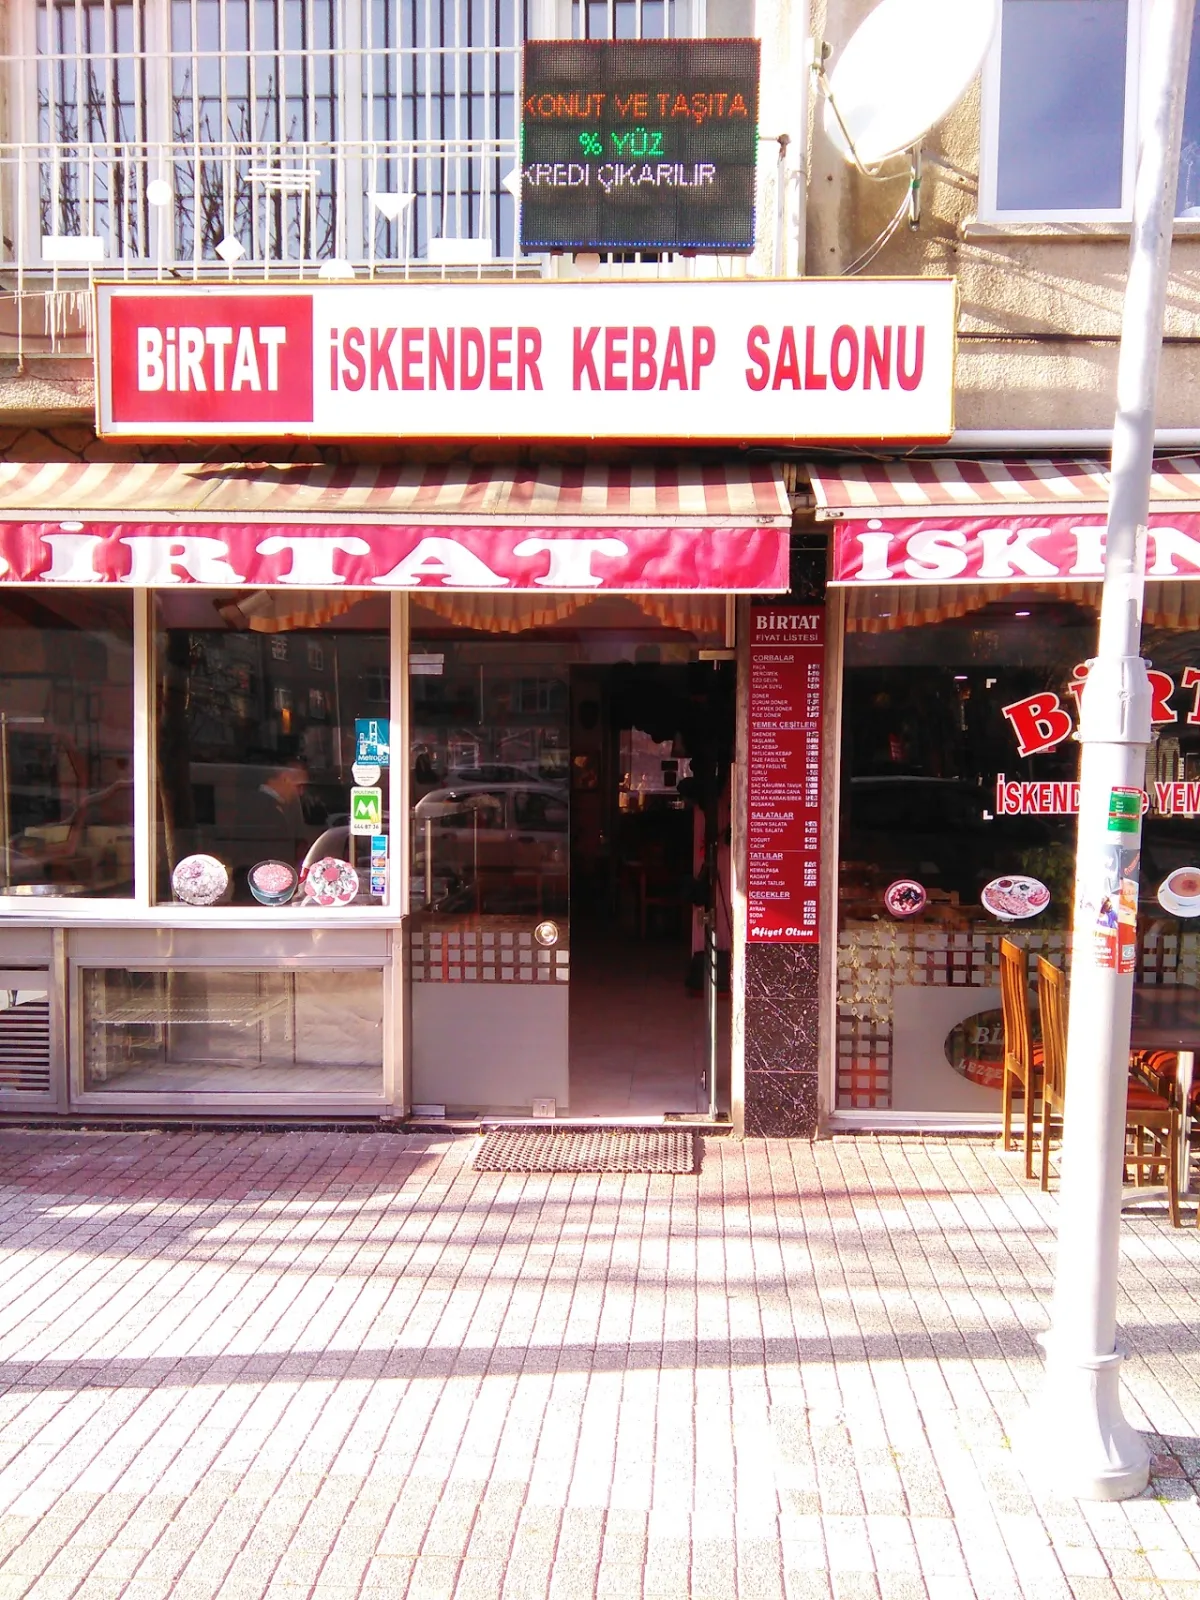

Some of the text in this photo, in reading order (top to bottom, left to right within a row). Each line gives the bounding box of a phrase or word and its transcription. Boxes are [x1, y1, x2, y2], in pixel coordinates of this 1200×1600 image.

[524, 93, 748, 123] KONUT VE TAŞITA
[579, 127, 664, 155] % YÜZ
[598, 163, 717, 193] ÇIKARILIR
[572, 325, 717, 391] KEBAP
[746, 324, 924, 391] SALONU
[0, 521, 627, 586] İRTAT
[756, 611, 820, 630] BİRTAT
[755, 632, 818, 641] FİYAT LİSTESİ
[752, 721, 817, 729] YEMEK ÇEŞİTLERİ
[751, 927, 813, 937] Afiyet Olsun
